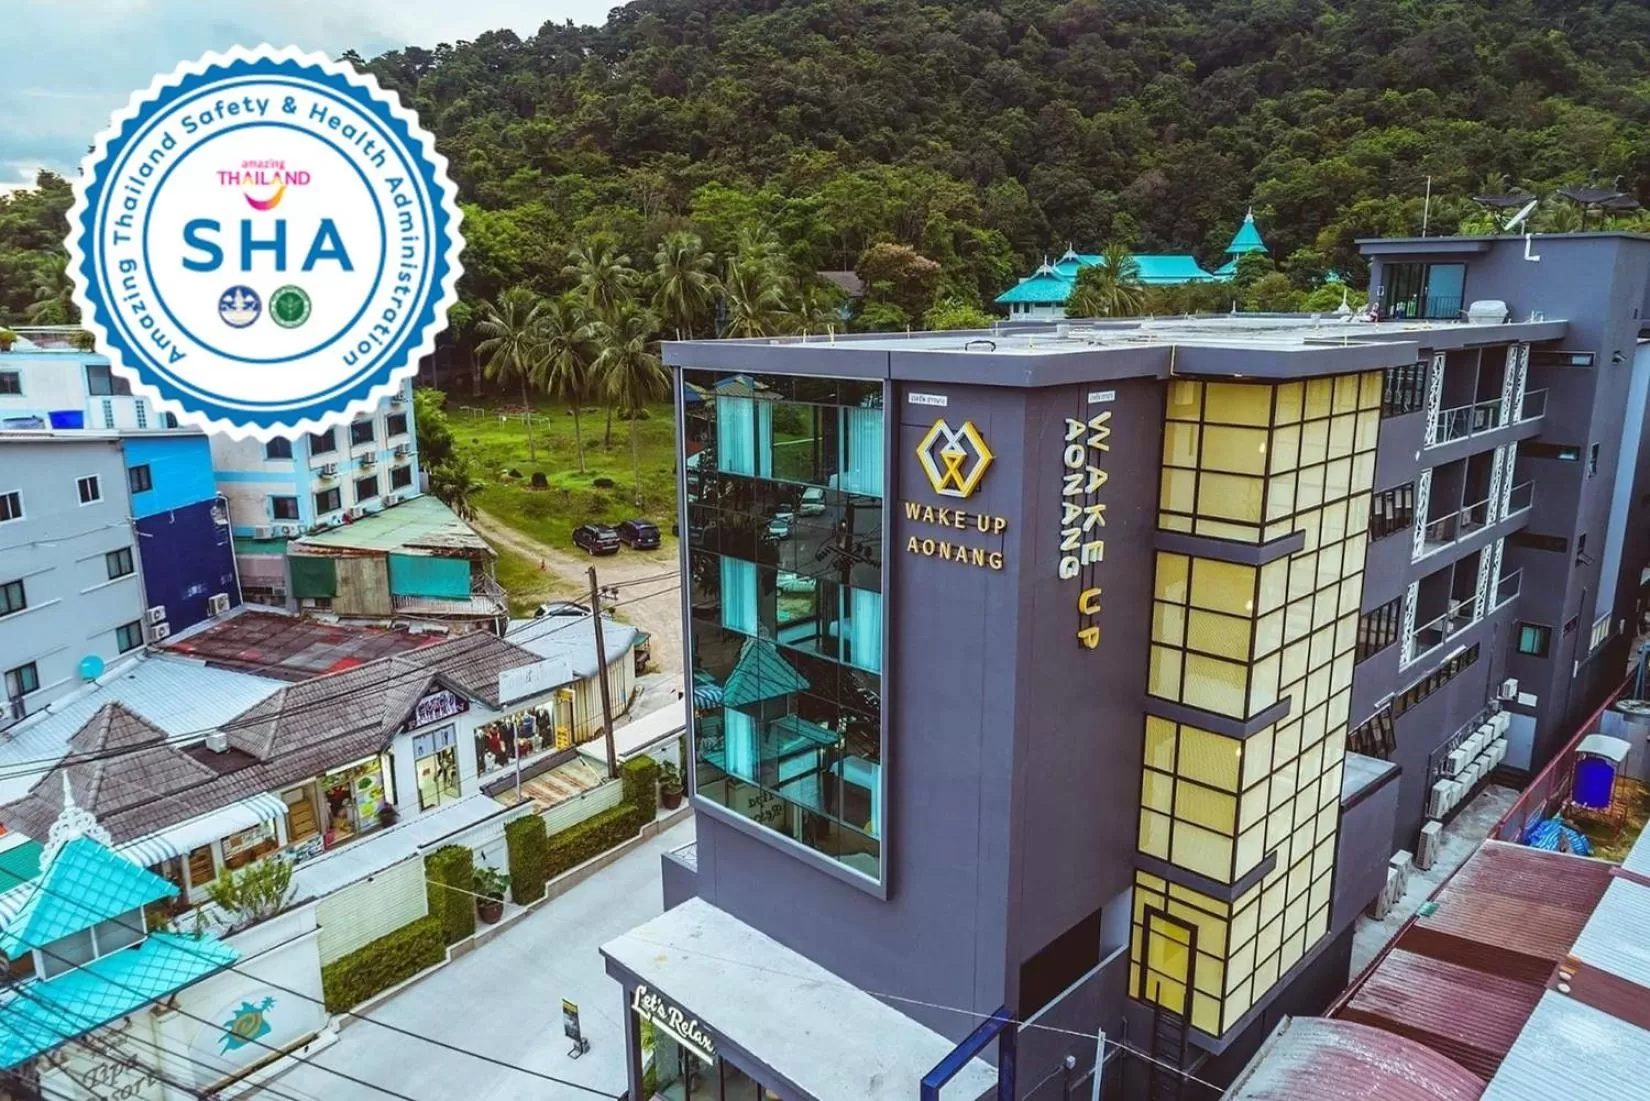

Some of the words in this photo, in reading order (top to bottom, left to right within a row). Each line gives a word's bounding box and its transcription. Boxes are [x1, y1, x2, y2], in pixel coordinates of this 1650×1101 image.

[905, 502, 967, 529] WAKE
[977, 515, 1007, 535] UP
[1059, 418, 1086, 579] AONANG
[1081, 411, 1112, 565] WAKE
[906, 536, 1004, 570] AONANG
[1077, 587, 1102, 650] UP
[631, 984, 668, 1022] Let's
[668, 1006, 714, 1052] Relax
